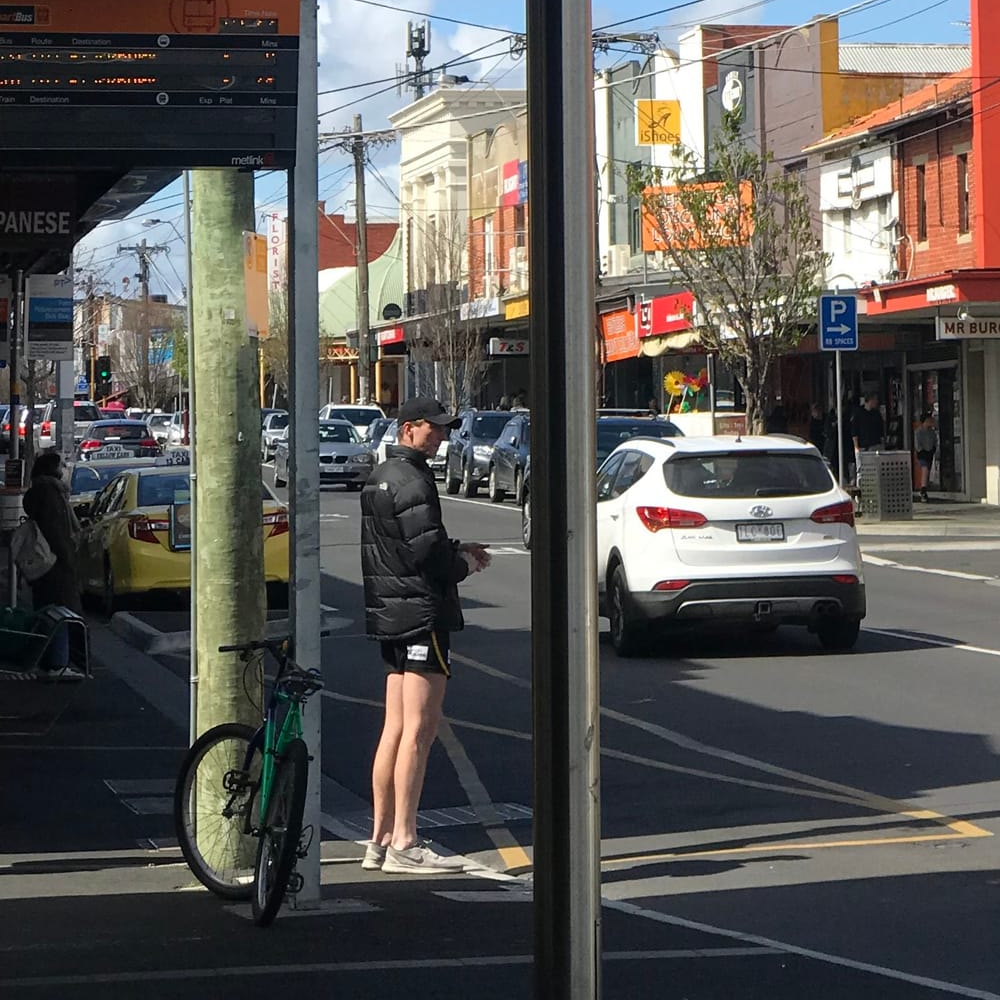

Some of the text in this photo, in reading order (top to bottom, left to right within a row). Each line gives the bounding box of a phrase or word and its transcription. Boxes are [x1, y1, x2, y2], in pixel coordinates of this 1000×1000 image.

[640, 130, 680, 142] iShoes
[231, 155, 264, 166] metlink
[271, 212, 280, 289] FLORIST
[831, 300, 847, 323] P
[944, 321, 965, 335] MR
